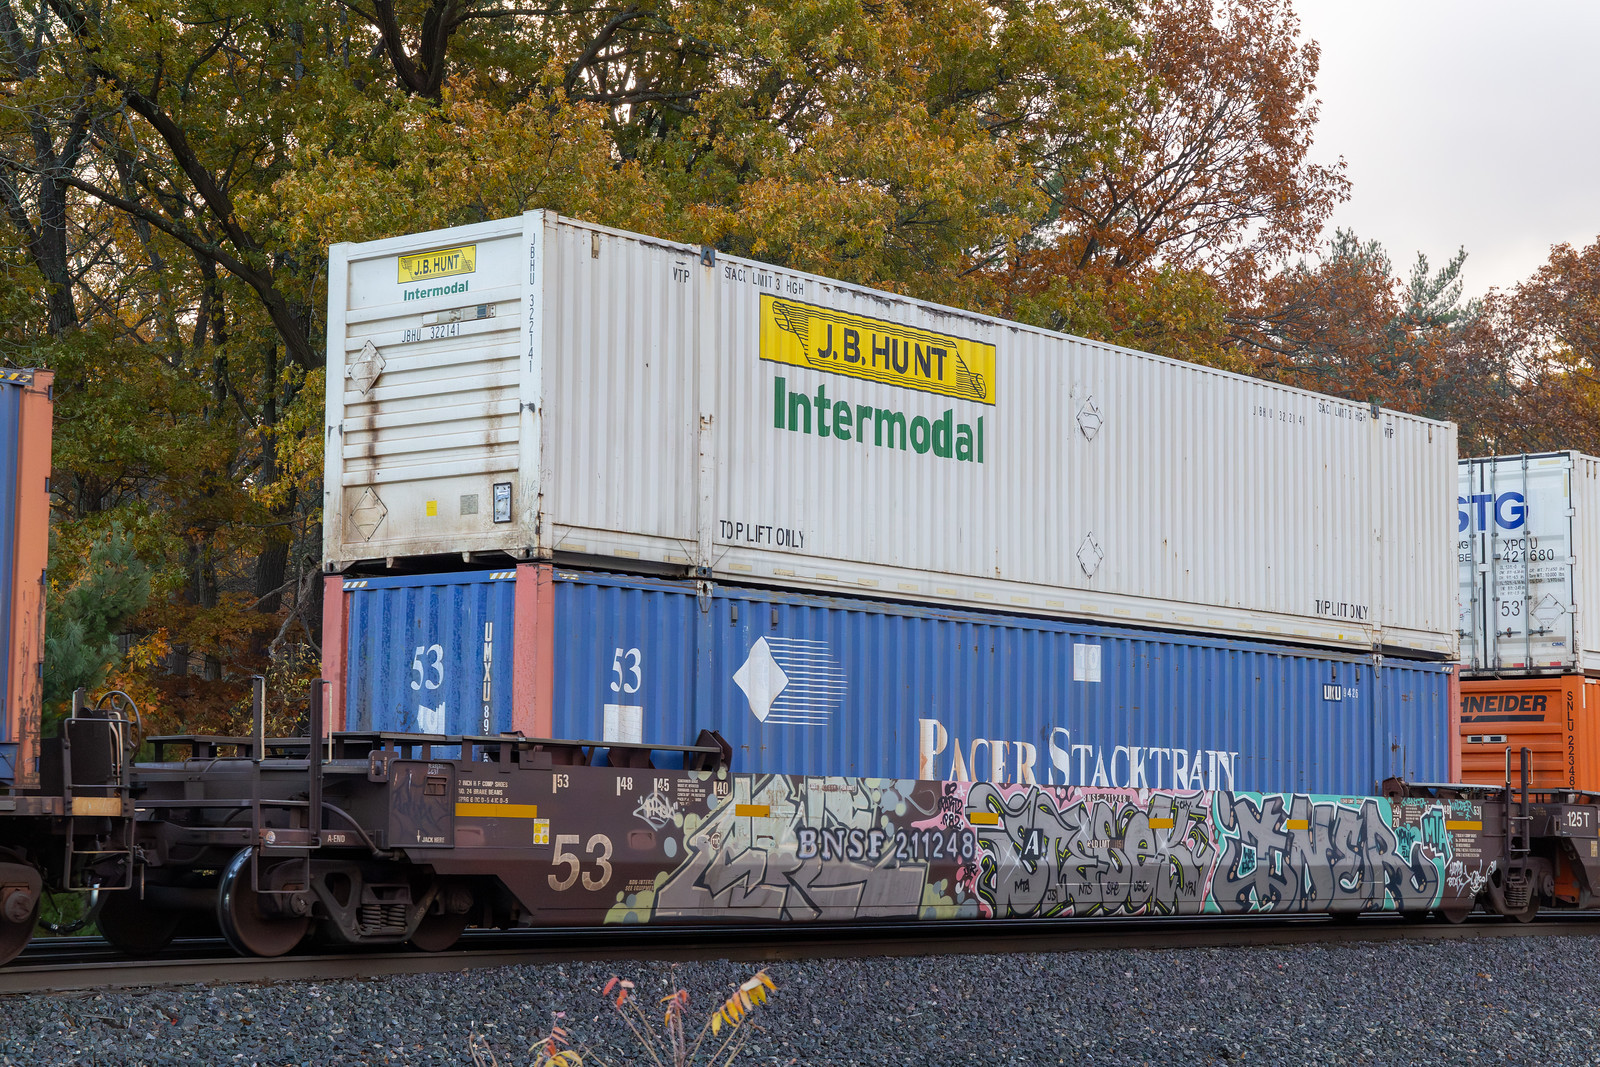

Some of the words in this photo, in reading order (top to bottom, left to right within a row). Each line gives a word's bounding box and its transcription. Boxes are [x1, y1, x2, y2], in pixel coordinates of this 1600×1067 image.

[434, 254, 460, 272] HUNT
[403, 280, 469, 301] Intermodal
[401, 328, 422, 343] JBHU
[430, 323, 460, 340] 322141
[871, 333, 947, 381] HUNT
[774, 376, 984, 464] Intermodal
[720, 520, 743, 540] TOP
[747, 524, 772, 544] LIFT
[776, 528, 804, 548] ONLY
[1503, 549, 1554, 562] 421680
[410, 644, 444, 691] 53
[482, 621, 493, 701] UMXU
[610, 647, 642, 694] 53
[1566, 691, 1574, 731] SNLU
[1567, 735, 1576, 789] 22348
[557, 774, 569, 788] 53
[620, 777, 633, 790] 48
[658, 778, 669, 791] 45
[717, 781, 728, 795] 40
[798, 829, 884, 860] BNSF
[896, 829, 974, 860] 211248
[547, 834, 613, 891] 53
